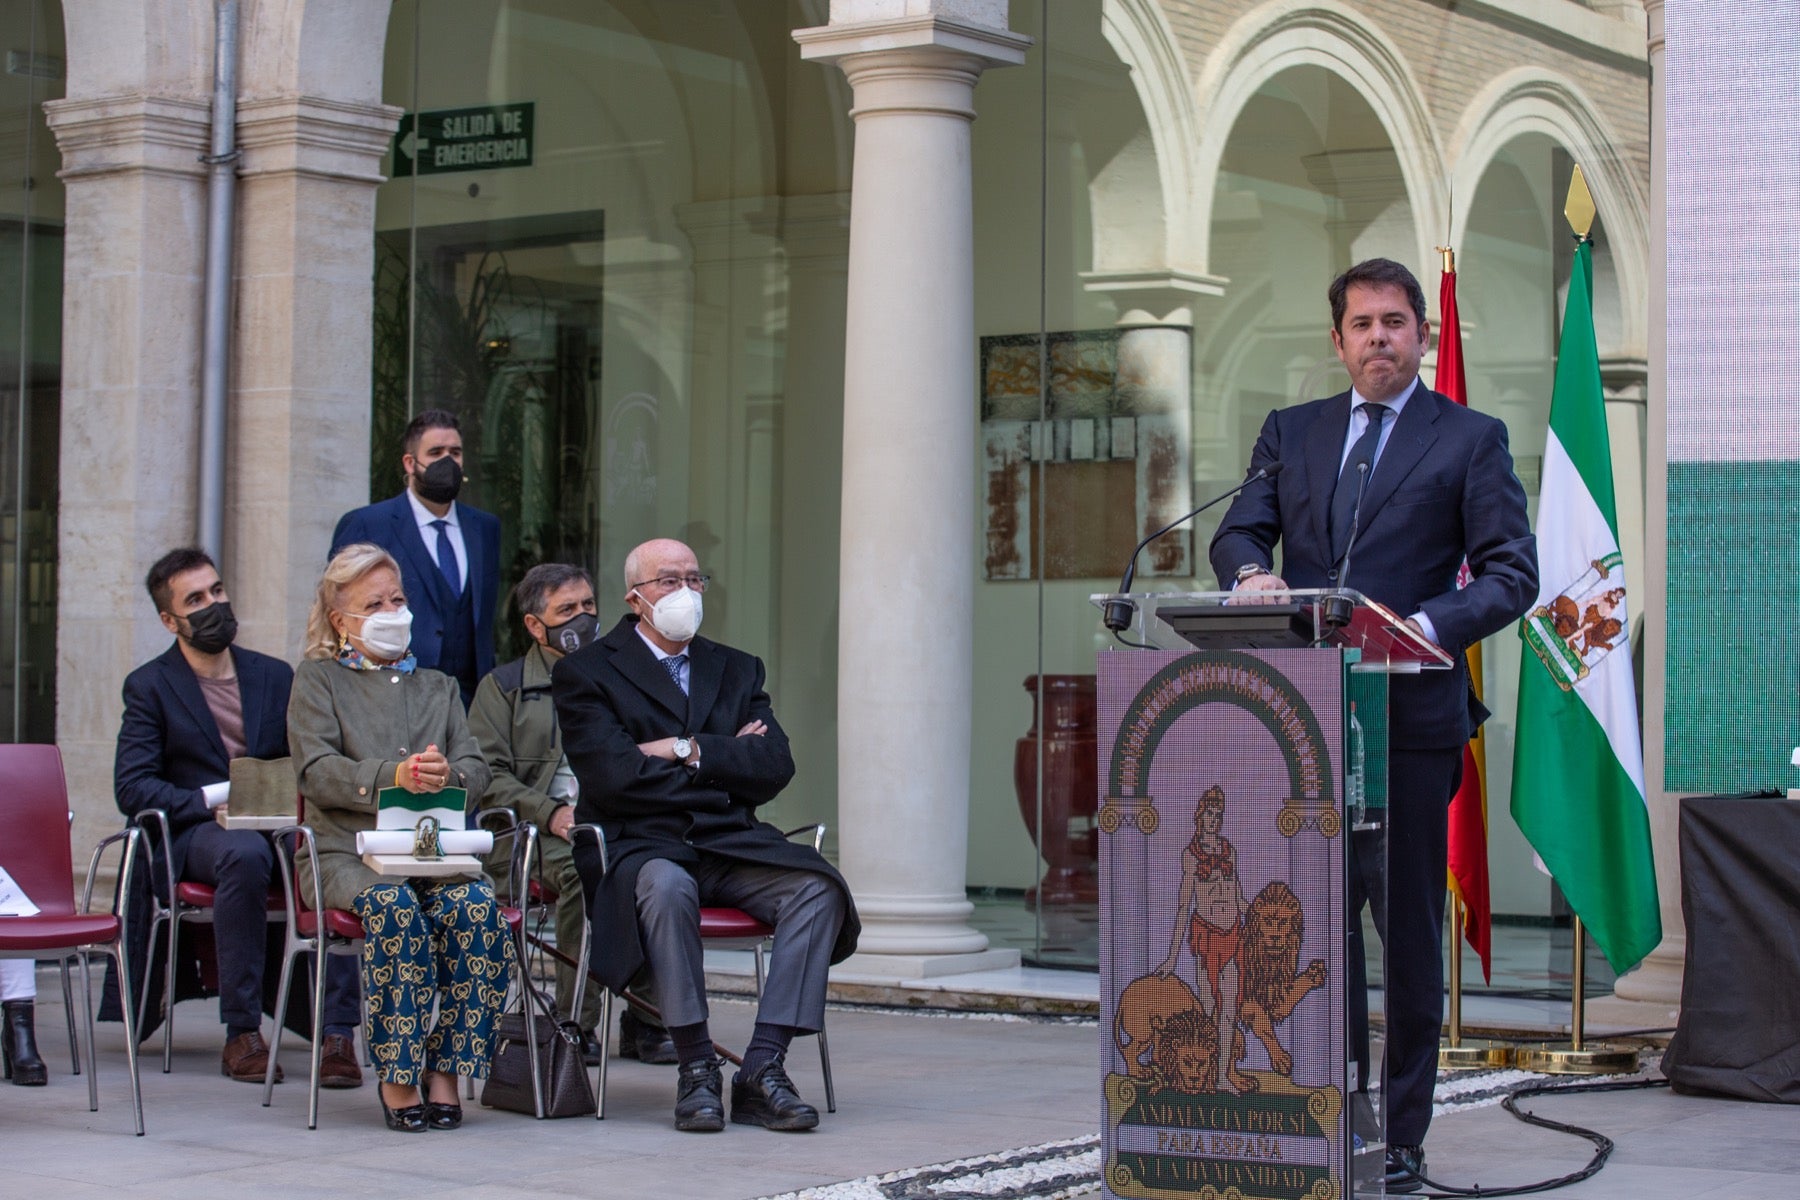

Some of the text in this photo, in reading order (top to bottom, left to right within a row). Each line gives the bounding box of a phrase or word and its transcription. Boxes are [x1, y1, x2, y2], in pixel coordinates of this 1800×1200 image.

[442, 111, 522, 139] SALIDA DE
[434, 138, 528, 167] EMERGENCIA
[1246, 1108, 1285, 1133] POR
[1288, 1111, 1306, 1135] SI
[1156, 1130, 1283, 1160] PARA ESPAÑA
